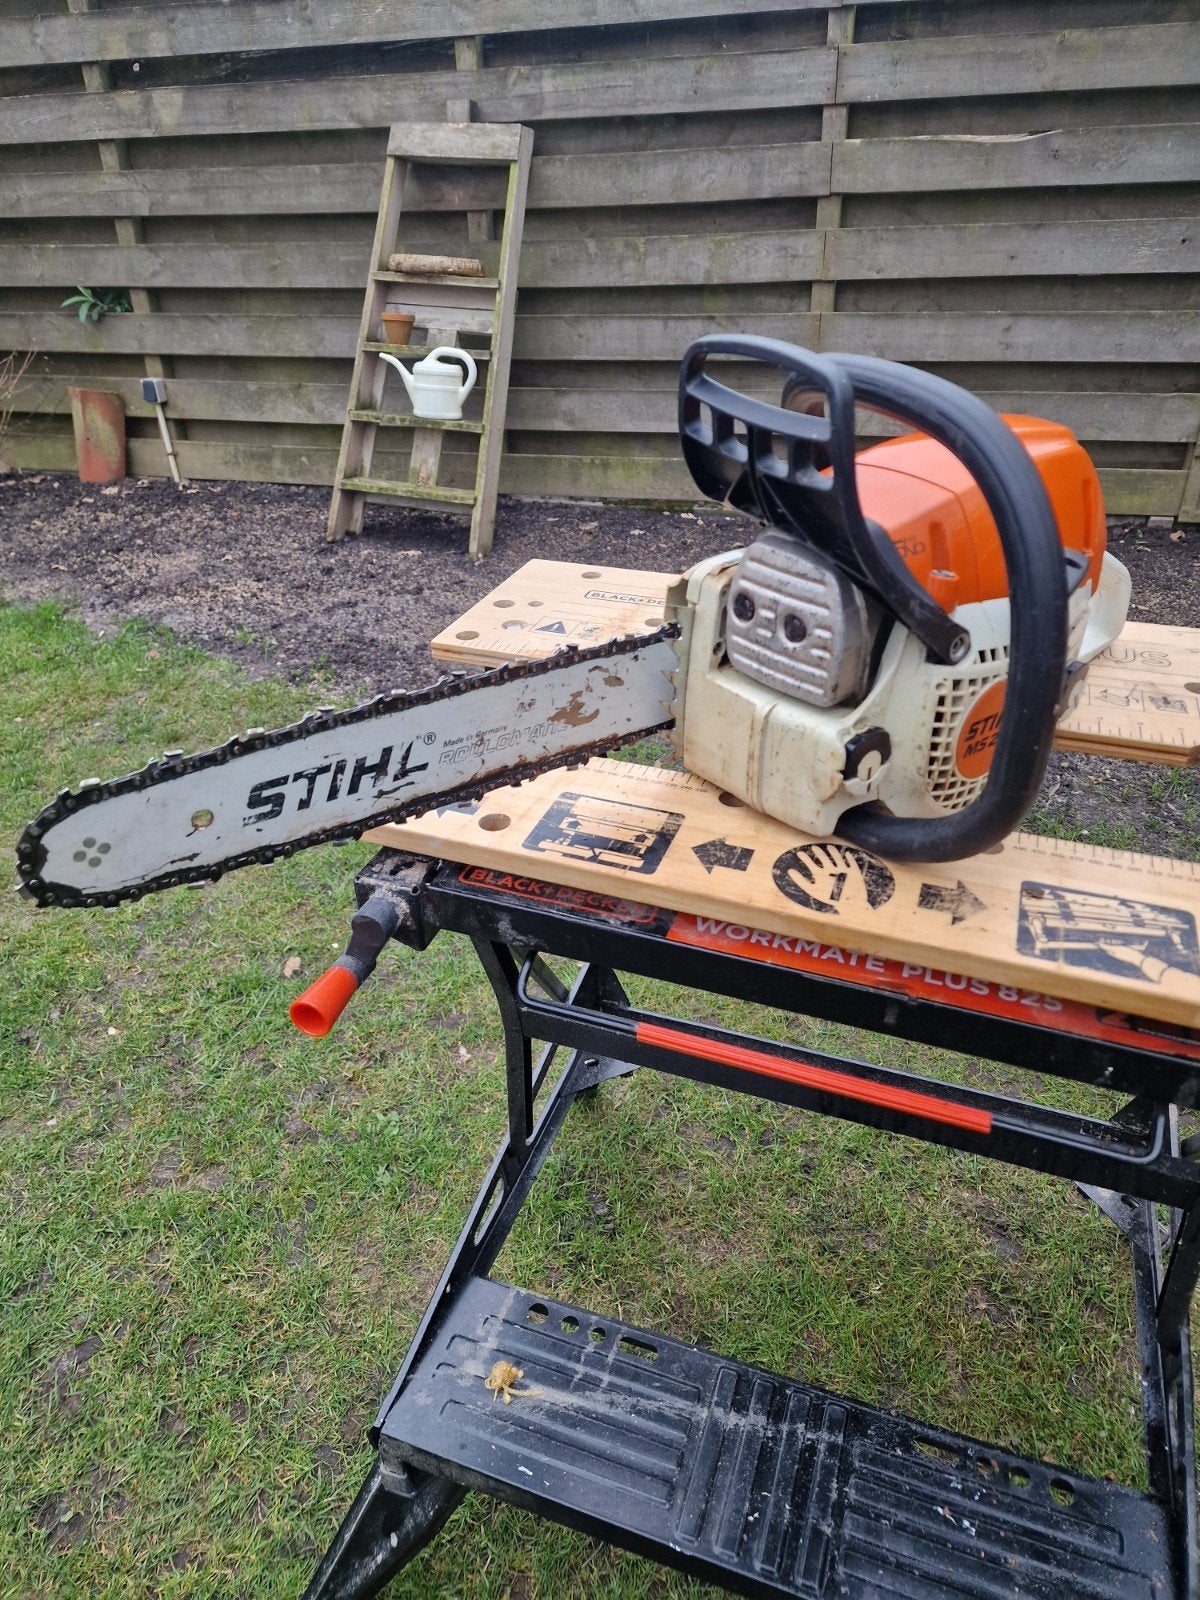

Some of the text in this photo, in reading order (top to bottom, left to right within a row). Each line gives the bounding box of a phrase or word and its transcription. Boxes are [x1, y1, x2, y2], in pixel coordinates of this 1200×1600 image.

[1097, 646, 1172, 668] US
[442, 736, 464, 748] Made
[475, 724, 508, 739] Germany
[243, 741, 429, 827] STIHL
[695, 916, 886, 973] WORKMATE
[902, 963, 990, 996] PLUS
